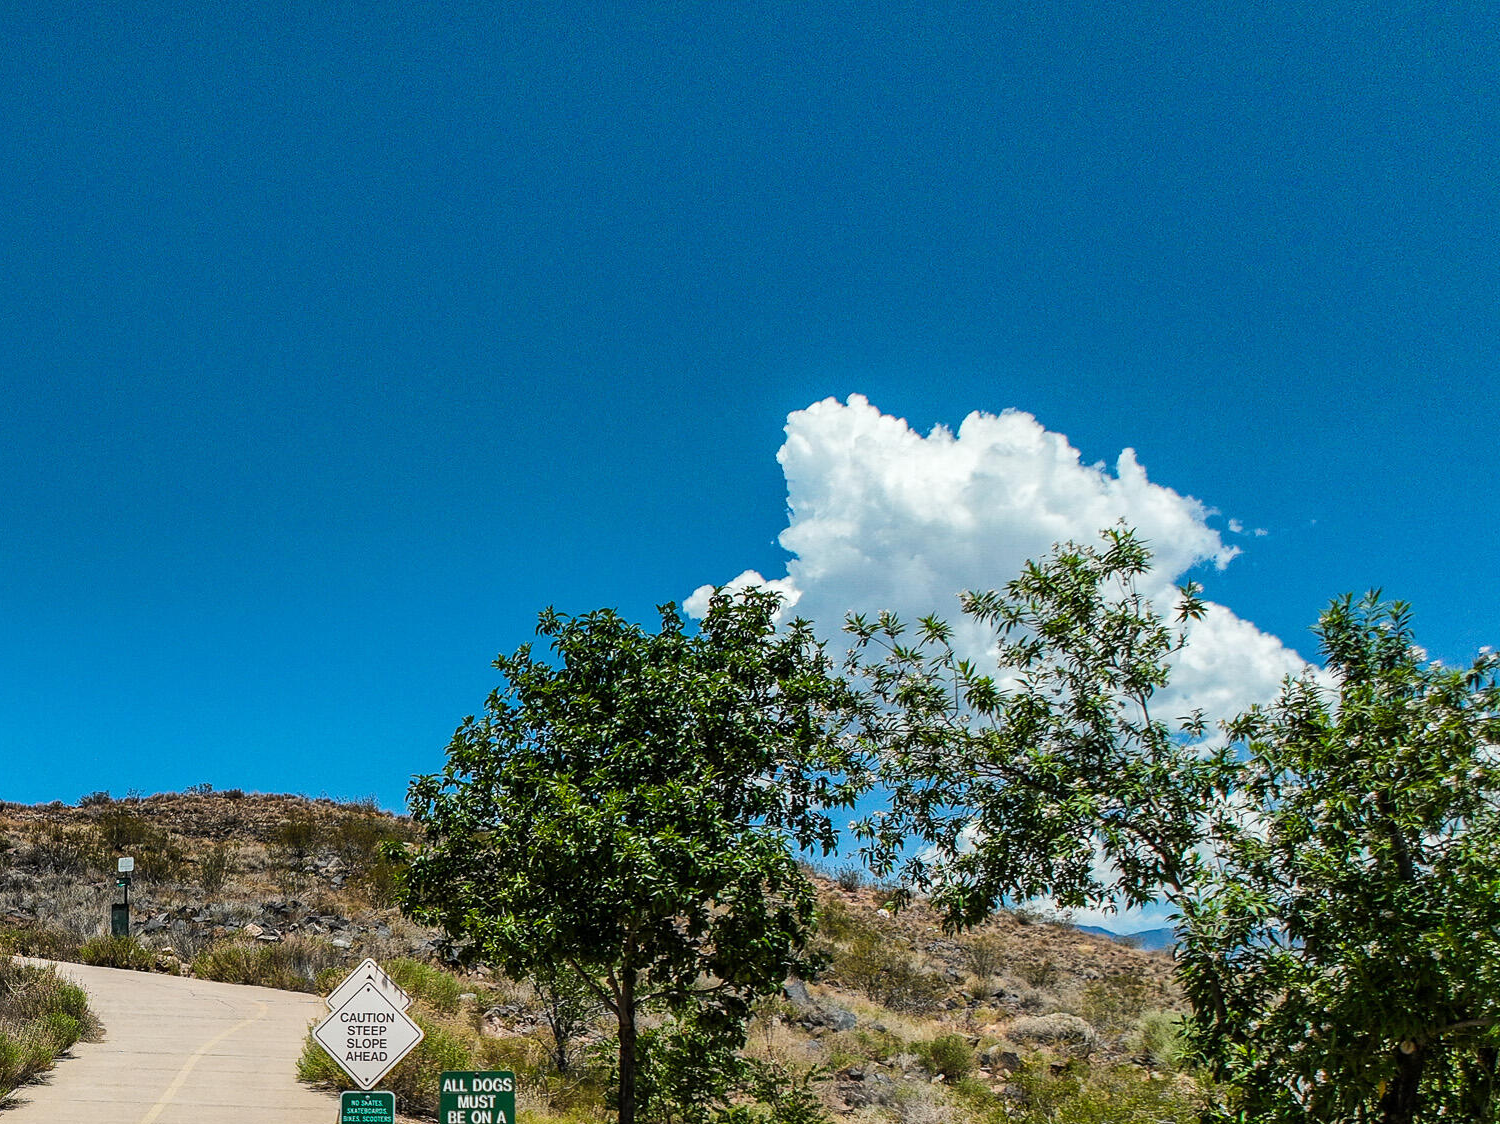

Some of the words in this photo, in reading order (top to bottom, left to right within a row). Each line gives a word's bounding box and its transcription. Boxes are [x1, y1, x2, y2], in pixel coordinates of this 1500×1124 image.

[340, 1012, 394, 1022] CAUTION
[347, 1026, 387, 1036] STEEP
[346, 1038, 388, 1048] SLOPE
[346, 1052, 388, 1062] AHEAD
[442, 1078, 468, 1092] ALL
[472, 1078, 512, 1092] DOGS
[458, 1094, 496, 1108] MUST
[448, 1110, 466, 1124] BE
[470, 1110, 492, 1124] ON
[496, 1110, 507, 1124] A
